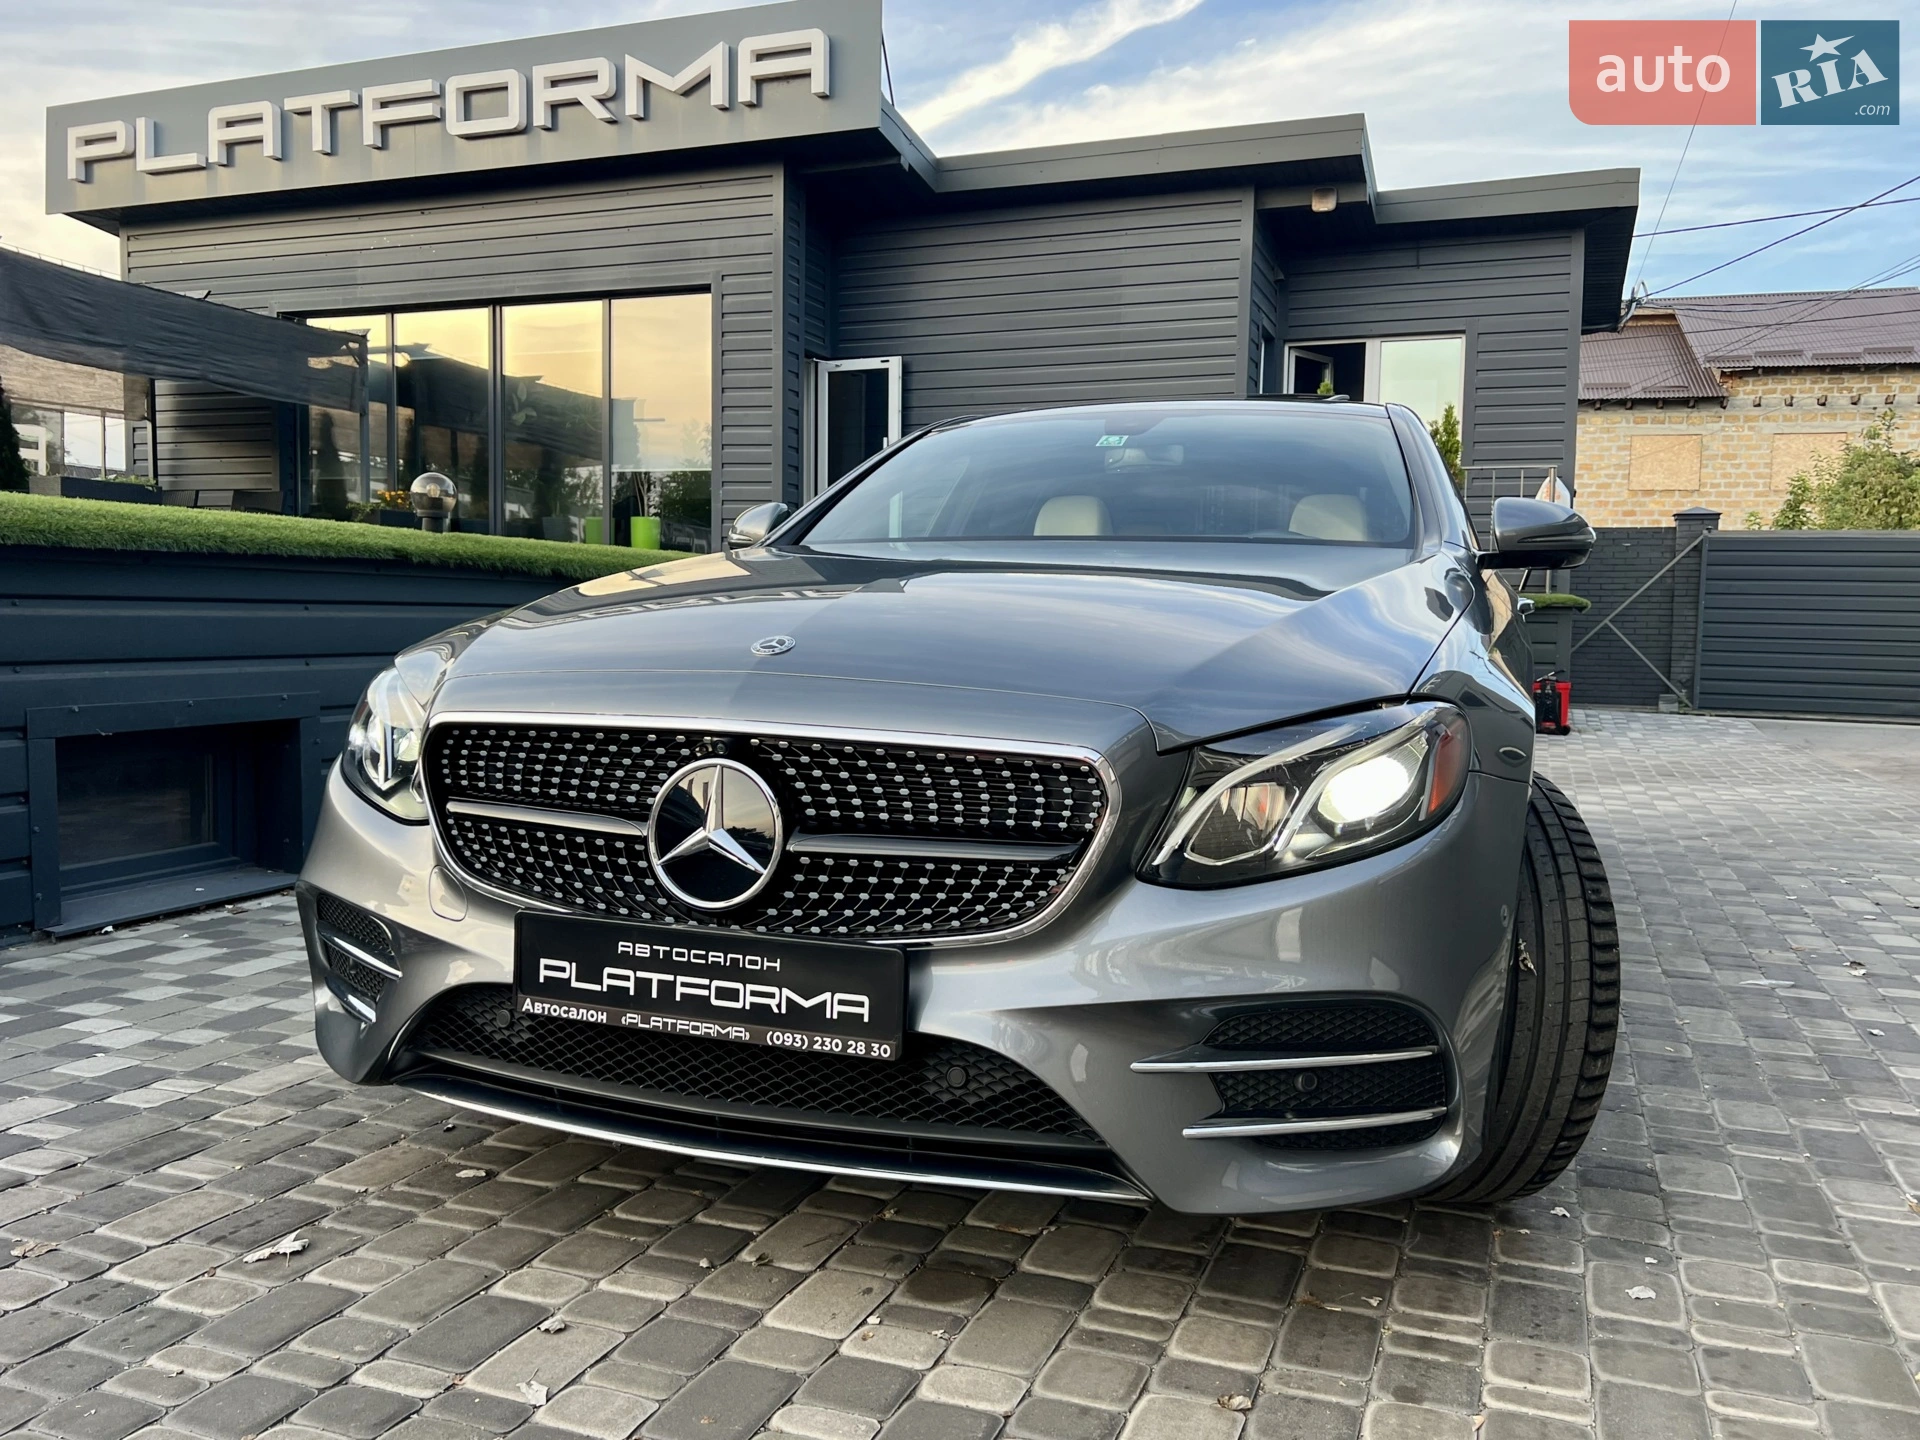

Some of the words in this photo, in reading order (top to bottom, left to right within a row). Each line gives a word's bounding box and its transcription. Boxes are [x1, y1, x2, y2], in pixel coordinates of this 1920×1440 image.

[67, 28, 830, 182] PLATFORMA
[617, 941, 781, 972] АВТОСАЛОН
[538, 958, 870, 1022] PLATFORMA
[522, 998, 607, 1024] Автосалон
[766, 1031, 809, 1050] (093)
[812, 1037, 842, 1052] 230
[846, 1040, 866, 1055] 28
[870, 1043, 891, 1058] 30
